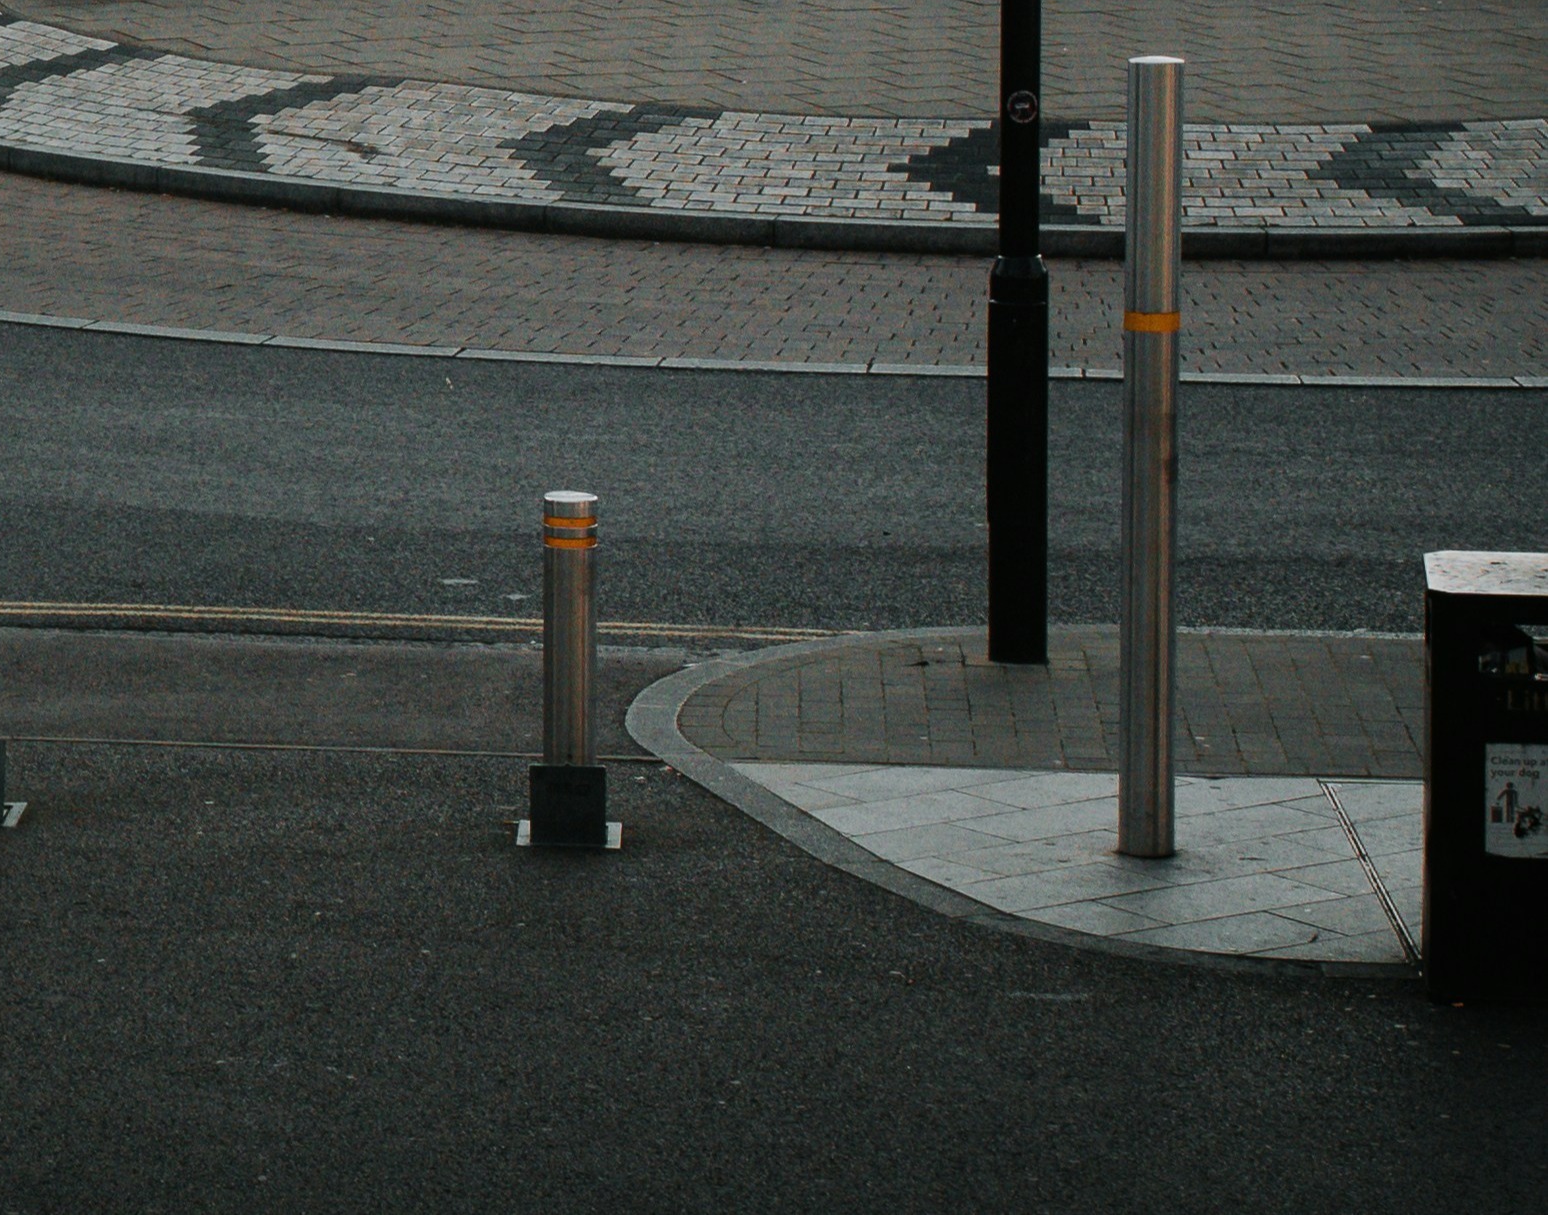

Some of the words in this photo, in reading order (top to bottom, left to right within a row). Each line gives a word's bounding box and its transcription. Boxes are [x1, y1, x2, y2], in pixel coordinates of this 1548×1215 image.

[1490, 756, 1521, 766] Clean
[1523, 757, 1537, 769] up
[1490, 769, 1515, 779] your
[1519, 767, 1540, 779] dog
